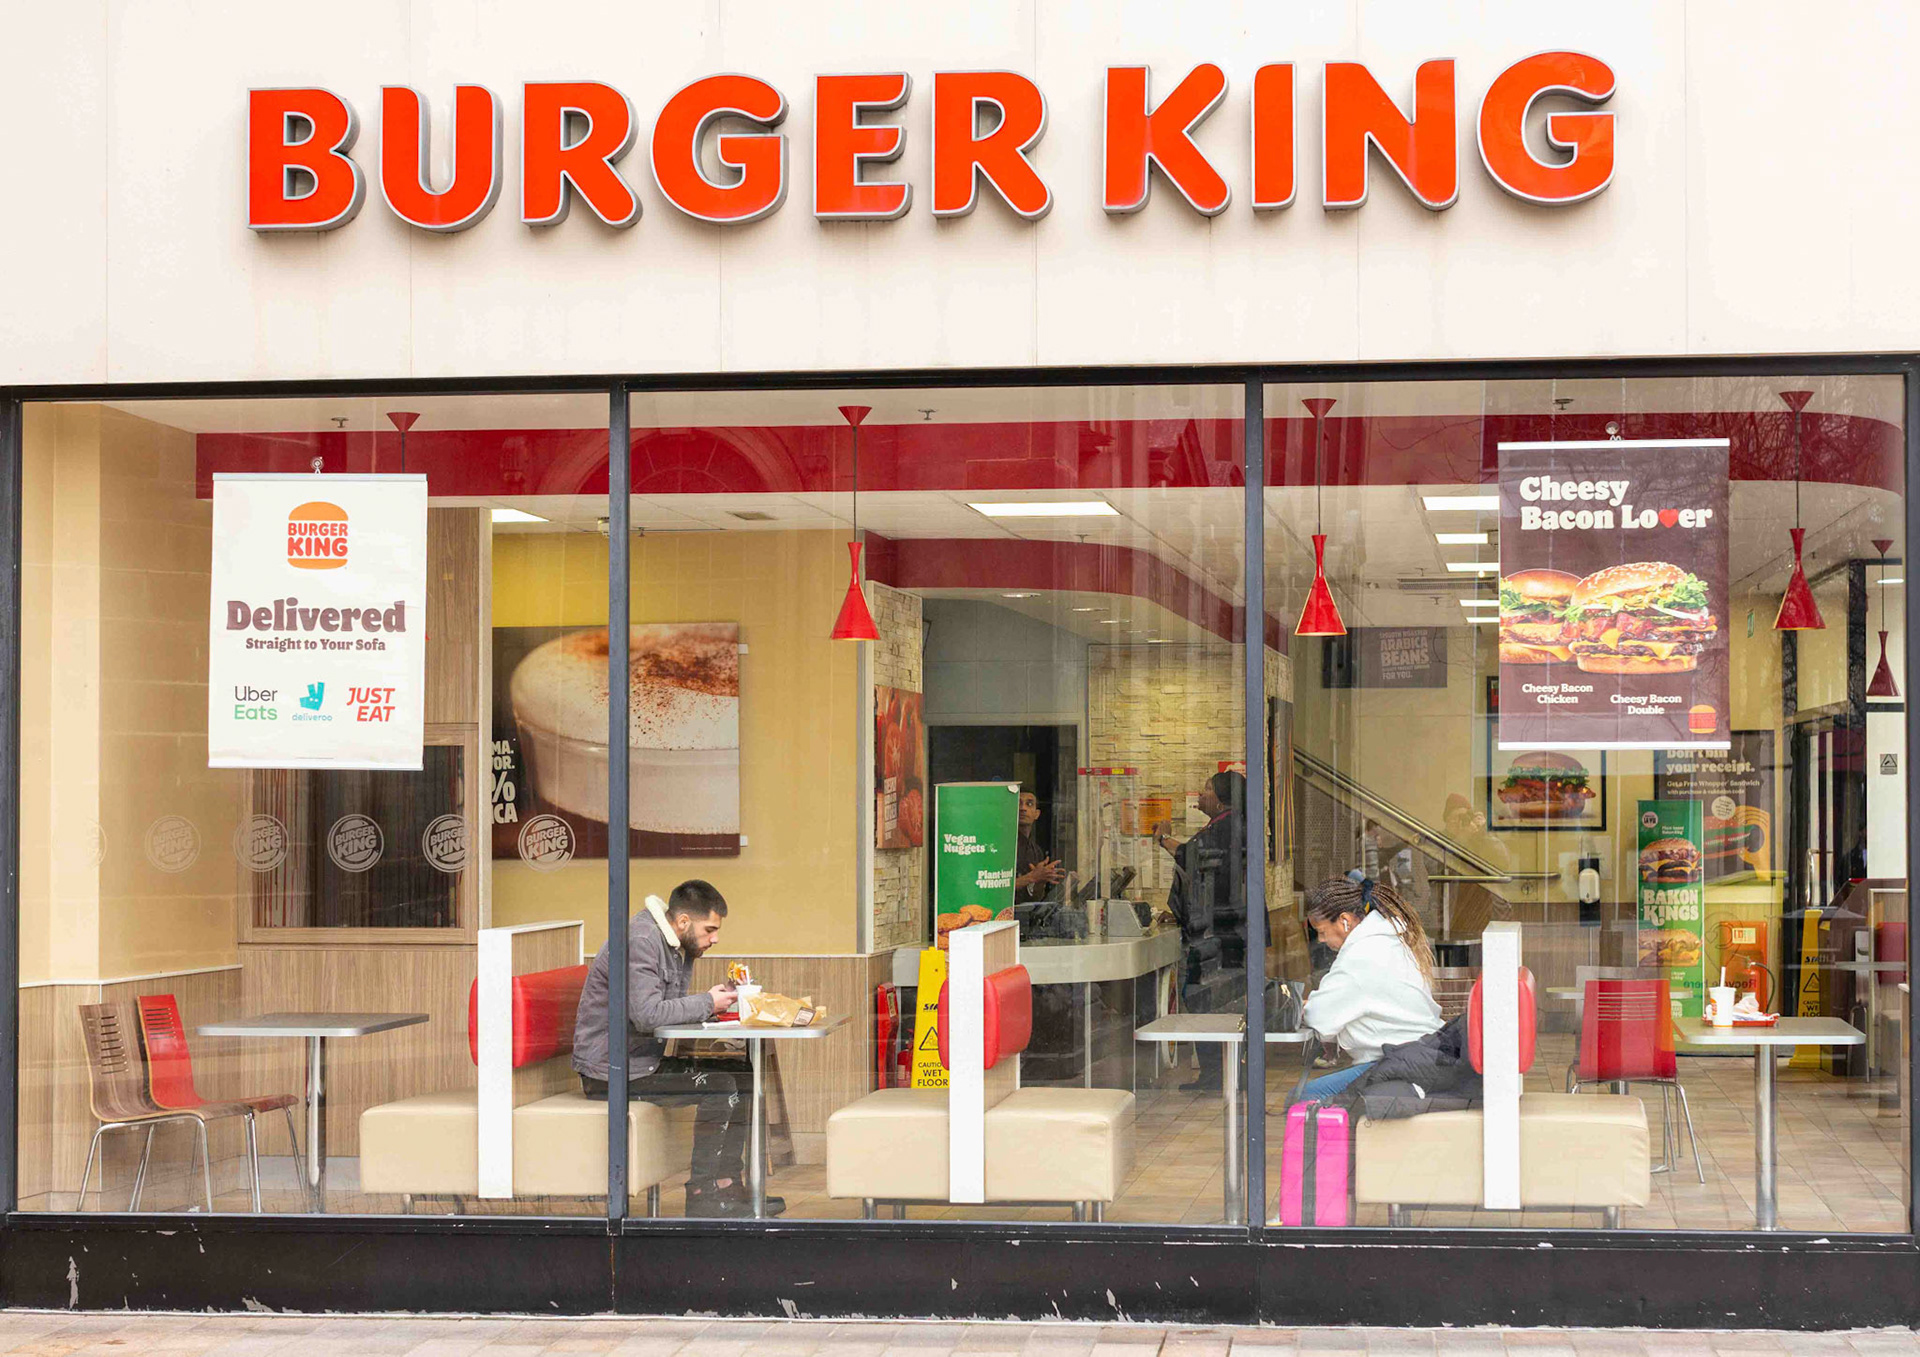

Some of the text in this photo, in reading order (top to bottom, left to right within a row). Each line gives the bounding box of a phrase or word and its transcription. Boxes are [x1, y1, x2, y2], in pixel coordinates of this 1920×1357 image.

[248, 48, 1619, 233] BURGER KING
[1520, 475, 1629, 506] Cheesy
[1520, 506, 1614, 530] Bacon
[288, 522, 348, 536] BURGER
[287, 537, 348, 557] KING
[226, 597, 406, 632] Delivered
[246, 637, 386, 652] Straight to Your Sofa
[1380, 636, 1428, 651] ARABICA
[1381, 648, 1432, 667] BEANS.
[1382, 672, 1396, 680] FOR
[234, 685, 278, 702] Uber
[346, 687, 396, 706] JUST
[1522, 684, 1593, 695] Cheesy Bacon
[1537, 695, 1579, 704] Chicken
[1610, 695, 1682, 706] Cheesy Bacon
[234, 704, 278, 720] Eats
[292, 713, 333, 721] deliveroo
[356, 706, 396, 722] EAT
[1628, 706, 1665, 714] Double
[1666, 759, 1755, 775] your receipt.
[335, 825, 375, 845] BURGER
[526, 826, 566, 846] BURGER
[944, 834, 976, 845] Vegan
[336, 835, 377, 859] KING
[528, 835, 568, 859] KING
[944, 844, 985, 855] Nuggets
[1643, 889, 1698, 905] BAKON
[1643, 905, 1699, 926] KINGS
